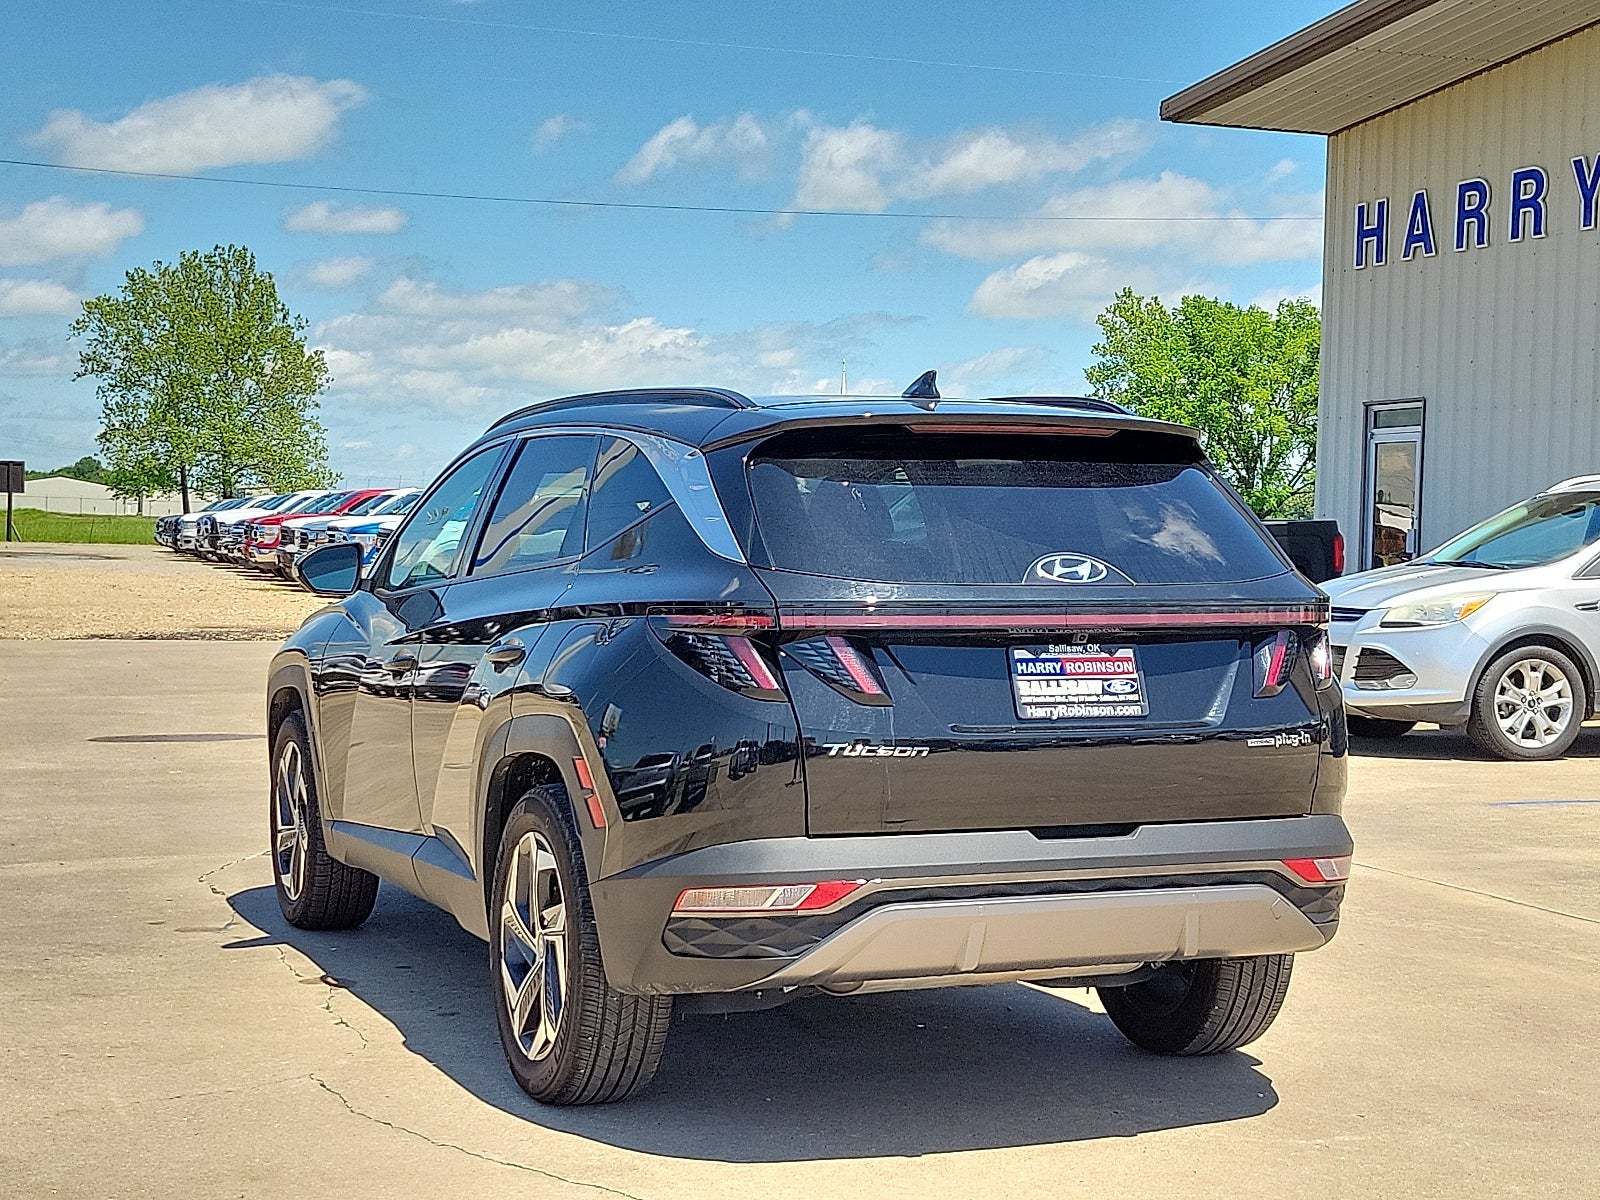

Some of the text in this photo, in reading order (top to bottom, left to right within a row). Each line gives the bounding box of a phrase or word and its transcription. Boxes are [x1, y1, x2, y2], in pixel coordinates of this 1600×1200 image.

[1353, 152, 1600, 270] HARRY
[1087, 643, 1101, 652] OK
[1016, 660, 1134, 674] HARRY ROBINSON
[1026, 704, 1142, 720] HarryRobinson.com
